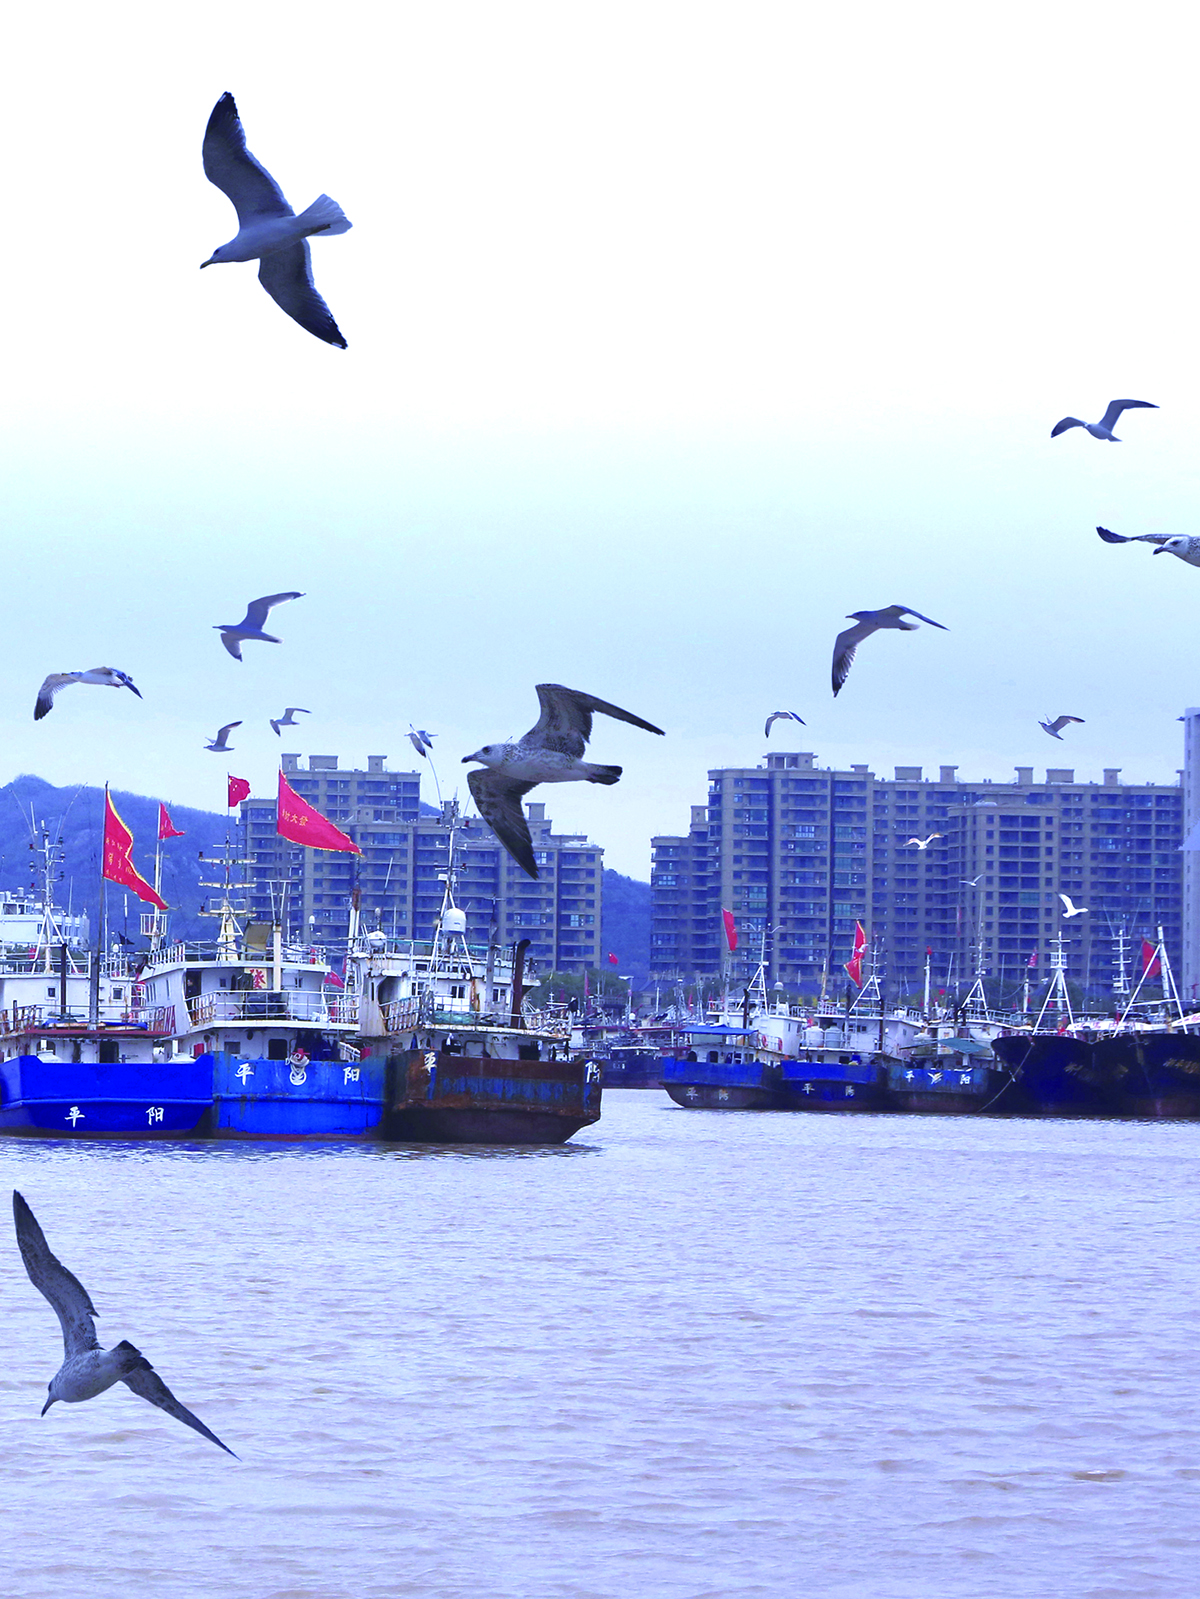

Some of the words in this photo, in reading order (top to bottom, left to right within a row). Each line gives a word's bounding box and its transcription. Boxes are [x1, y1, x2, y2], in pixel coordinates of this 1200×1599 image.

[234, 1062, 255, 1086] 平
[343, 1066, 360, 1086] 阳
[64, 1106, 86, 1128] 平
[145, 1106, 165, 1126] 阳
